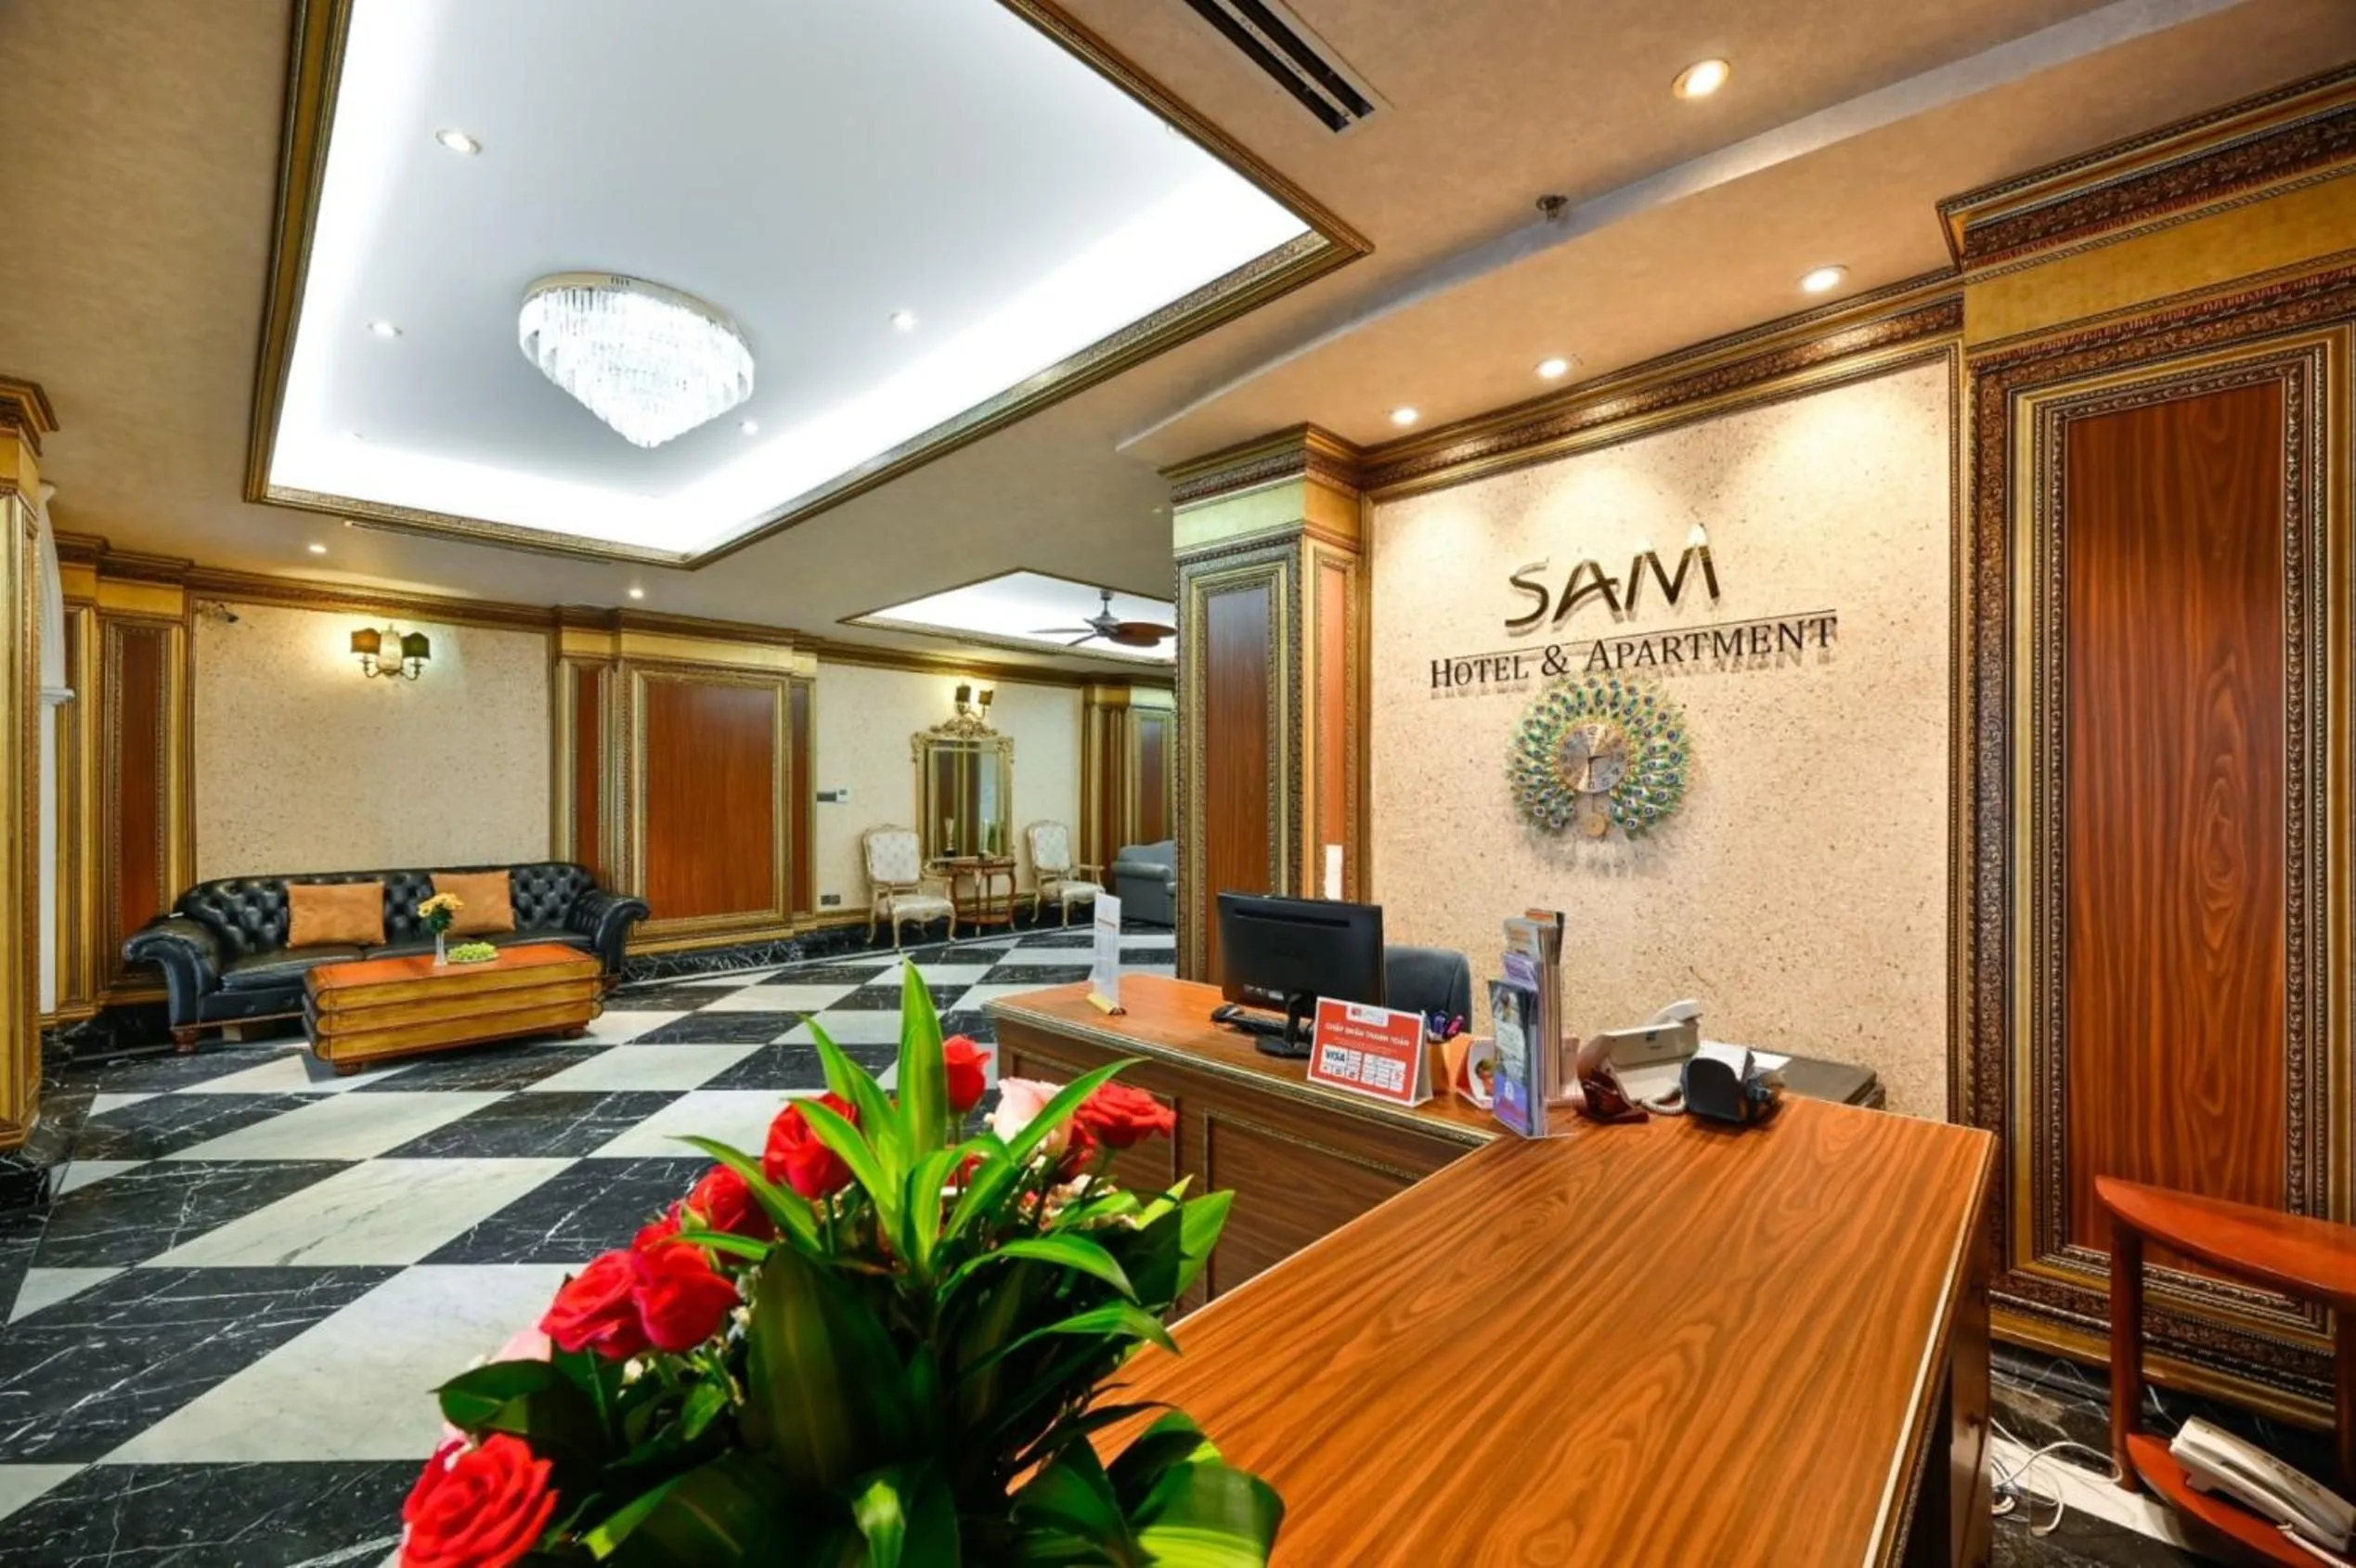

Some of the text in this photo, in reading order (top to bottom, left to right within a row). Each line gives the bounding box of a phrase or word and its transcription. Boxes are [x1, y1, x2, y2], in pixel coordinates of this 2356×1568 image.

[1504, 523, 1721, 628] SAM
[1430, 616, 1838, 689] HOTEL & APARTMENT
